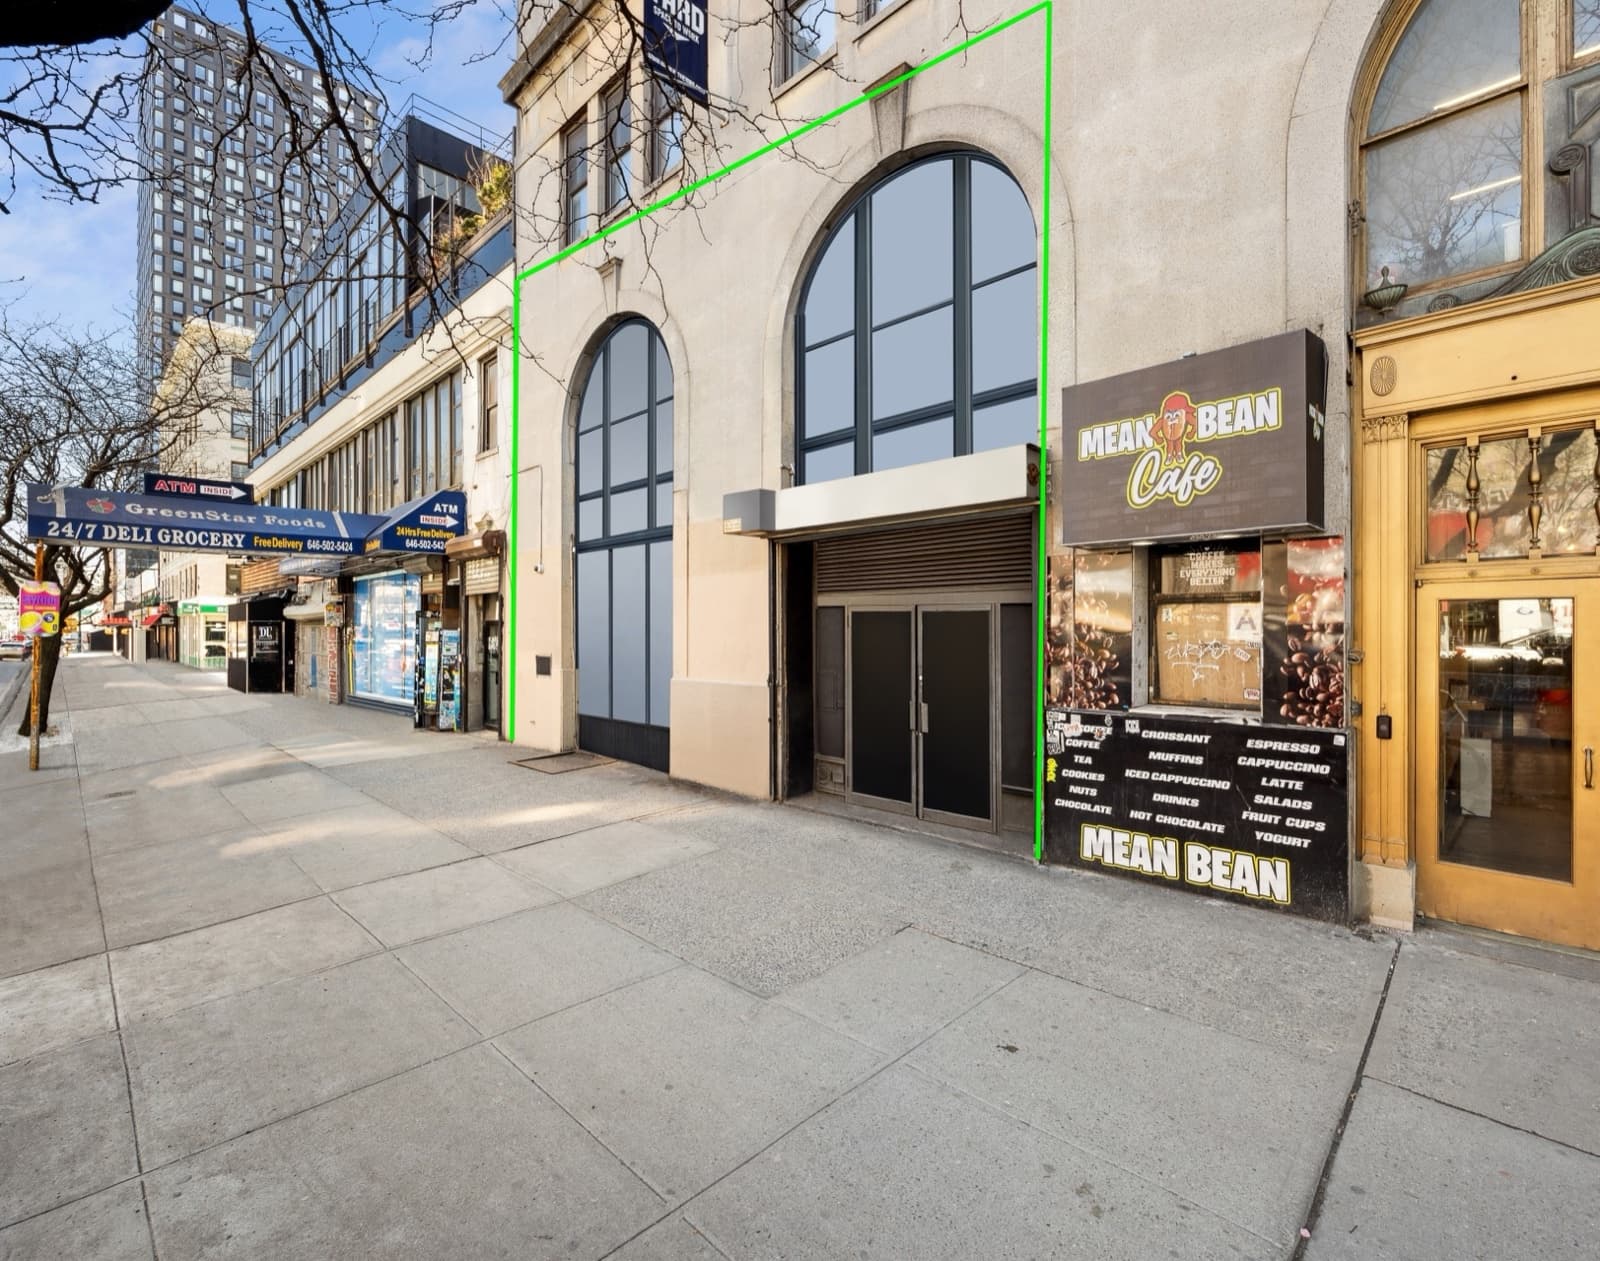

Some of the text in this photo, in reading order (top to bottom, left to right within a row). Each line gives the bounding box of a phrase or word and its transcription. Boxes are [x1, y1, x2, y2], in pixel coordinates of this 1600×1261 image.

[653, 0, 705, 35] ARD
[1080, 415, 1154, 459] MEAN
[1197, 390, 1279, 439] BEAN
[1131, 450, 1221, 505] Cafe
[154, 479, 234, 496] ATM INSIDE
[124, 502, 327, 529] GreenStar Foods
[434, 503, 458, 514] ATM
[422, 515, 447, 524] INSIDE
[47, 521, 246, 548] 24/7 DELI GROCERY
[306, 539, 353, 552] 646-502-5424
[1191, 560, 1224, 568] MAKES
[1235, 608, 1257, 630] A
[1065, 738, 1100, 750] COFFEE
[1141, 729, 1211, 744] CROISSANT
[1246, 738, 1320, 754] ESPRESSO
[1074, 754, 1093, 765] TEA
[1148, 751, 1204, 765] MUFFINS
[1237, 756, 1331, 775] CAPPUCCINO
[1061, 768, 1105, 782] COOKIES
[1125, 768, 1231, 790] ICED CAPPUCCINO
[1068, 785, 1098, 797] NUTS
[1261, 777, 1304, 791] LATTE
[1054, 798, 1113, 816] CHOCOLATE
[1152, 793, 1200, 807] DRINKS
[1253, 794, 1313, 810] SALADS
[1129, 809, 1226, 834] HOT CHOCOLATE
[1241, 810, 1326, 832] FRUIT CUPS
[1255, 831, 1312, 848] YOGURT
[1082, 825, 1289, 902] MEAN BEAN
